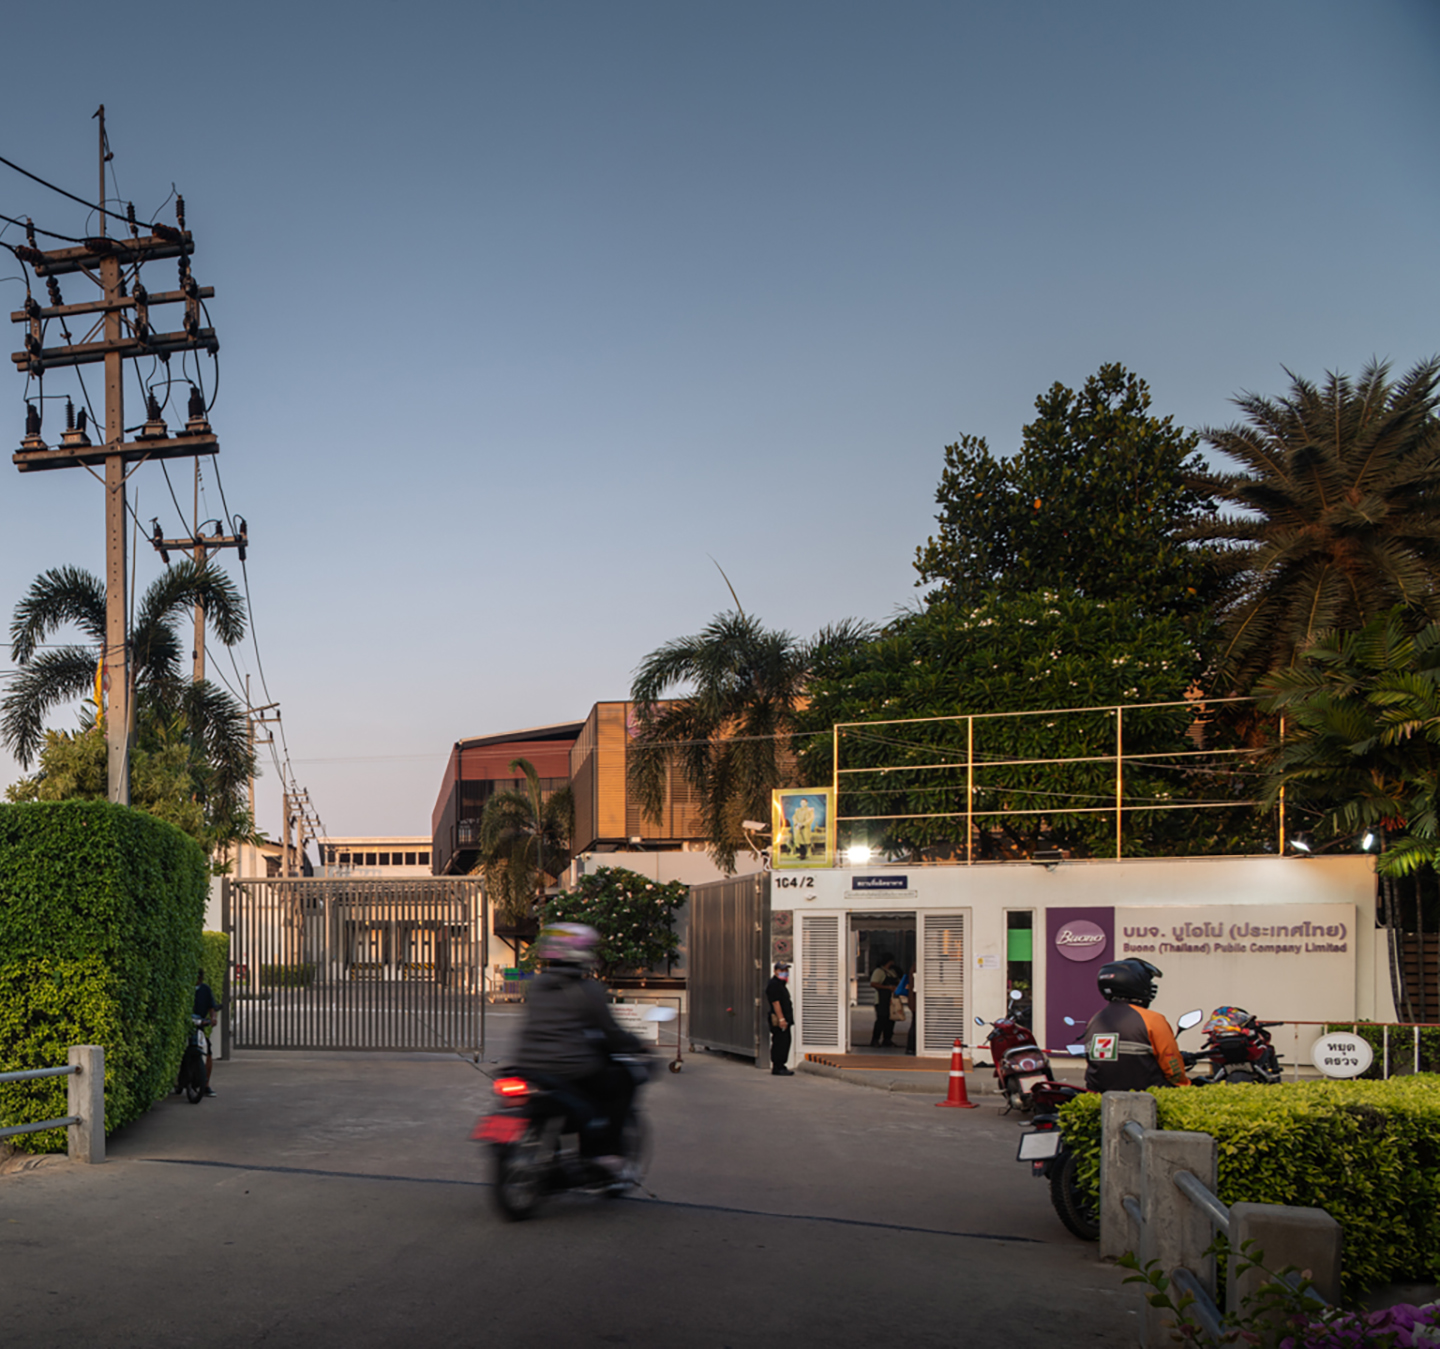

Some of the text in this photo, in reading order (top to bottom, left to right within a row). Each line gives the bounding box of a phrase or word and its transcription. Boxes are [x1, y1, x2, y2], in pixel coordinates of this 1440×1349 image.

[1056, 930, 1106, 945] Buono
[1123, 921, 1347, 942] บมจ. บูโอโน่ (ประเทศไทย)
[1123, 942, 1347, 955] Buono (Thailand) Public Company Limited
[1327, 1043, 1356, 1056] หยุด
[1324, 1057, 1359, 1066] ตรวจ
